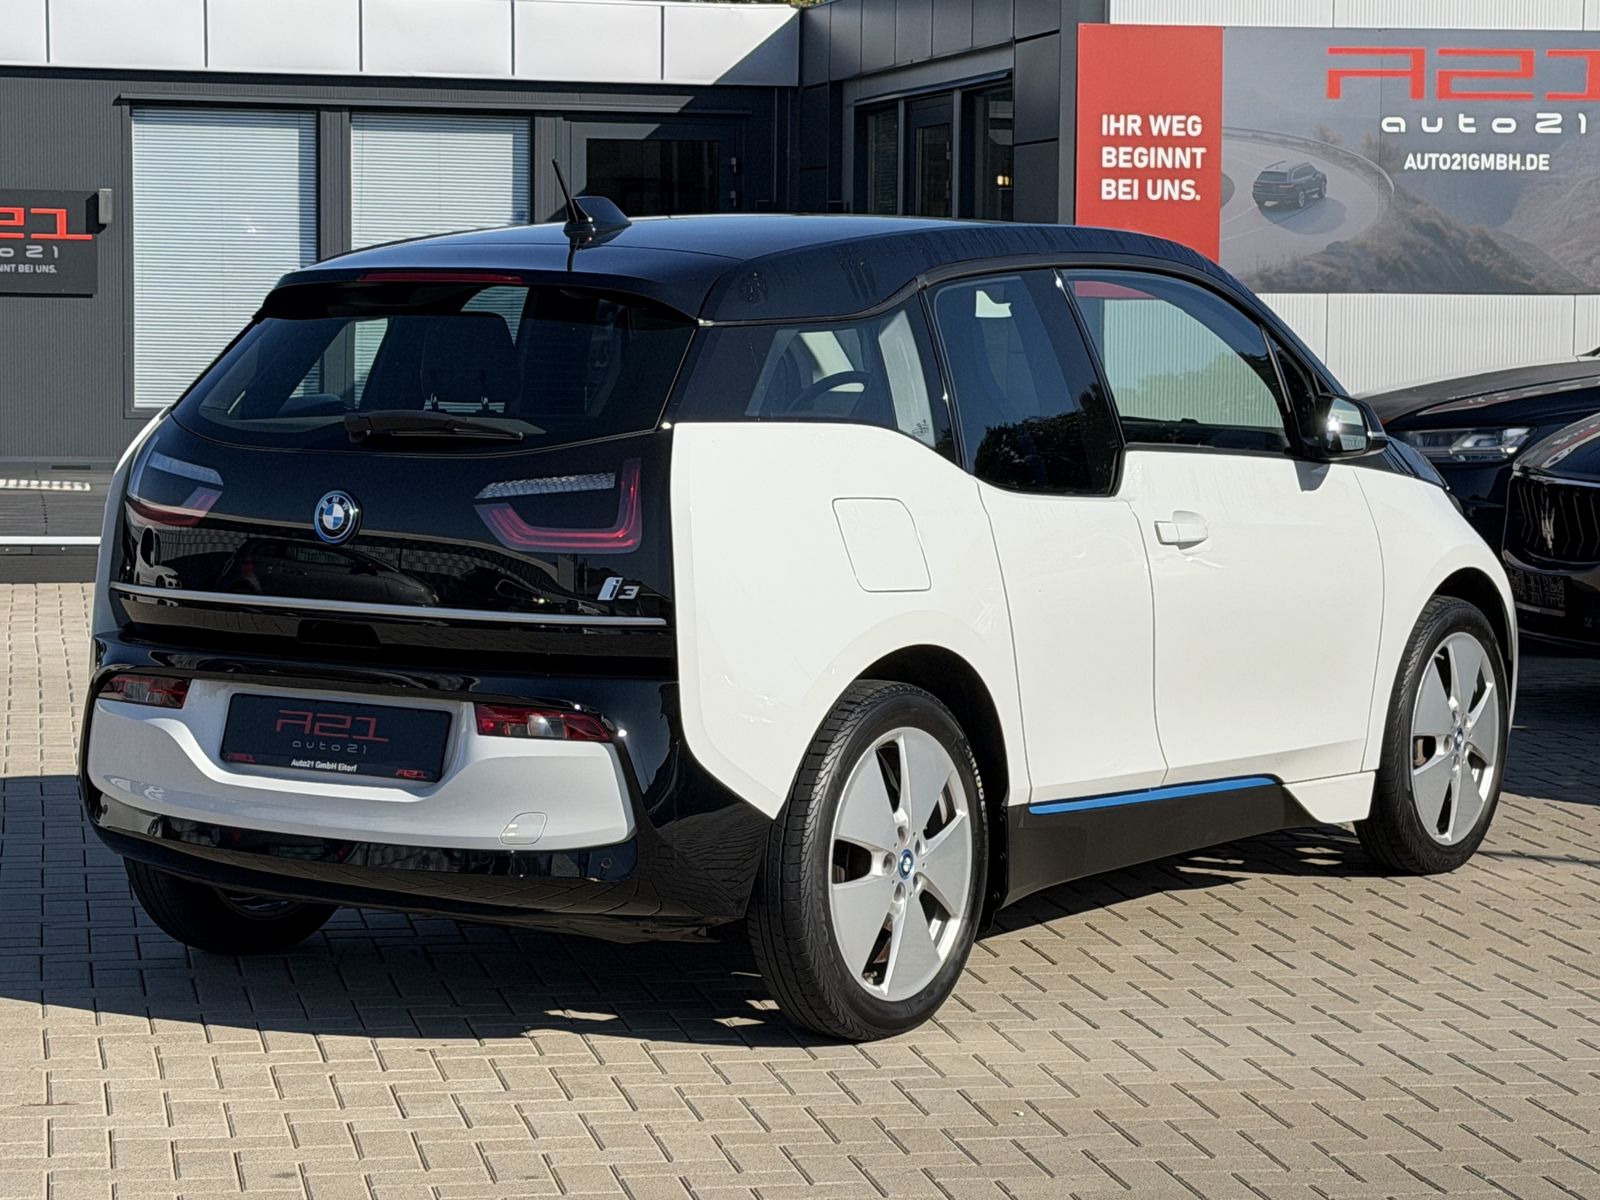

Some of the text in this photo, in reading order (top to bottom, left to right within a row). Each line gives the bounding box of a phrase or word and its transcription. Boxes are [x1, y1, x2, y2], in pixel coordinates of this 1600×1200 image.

[1101, 114, 1203, 137] IHR WEG
[1101, 146, 1207, 169] BEGINNT
[1404, 153, 1550, 171] AUTO21GMBH.DE
[1101, 178, 1201, 201] BEI UNS.
[18, 263, 33, 273] BEI
[35, 264, 58, 274] UNS.
[597, 576, 640, 600] i3
[275, 709, 389, 742] A21
[290, 758, 358, 773] Auto21 GmbH Eitorf
